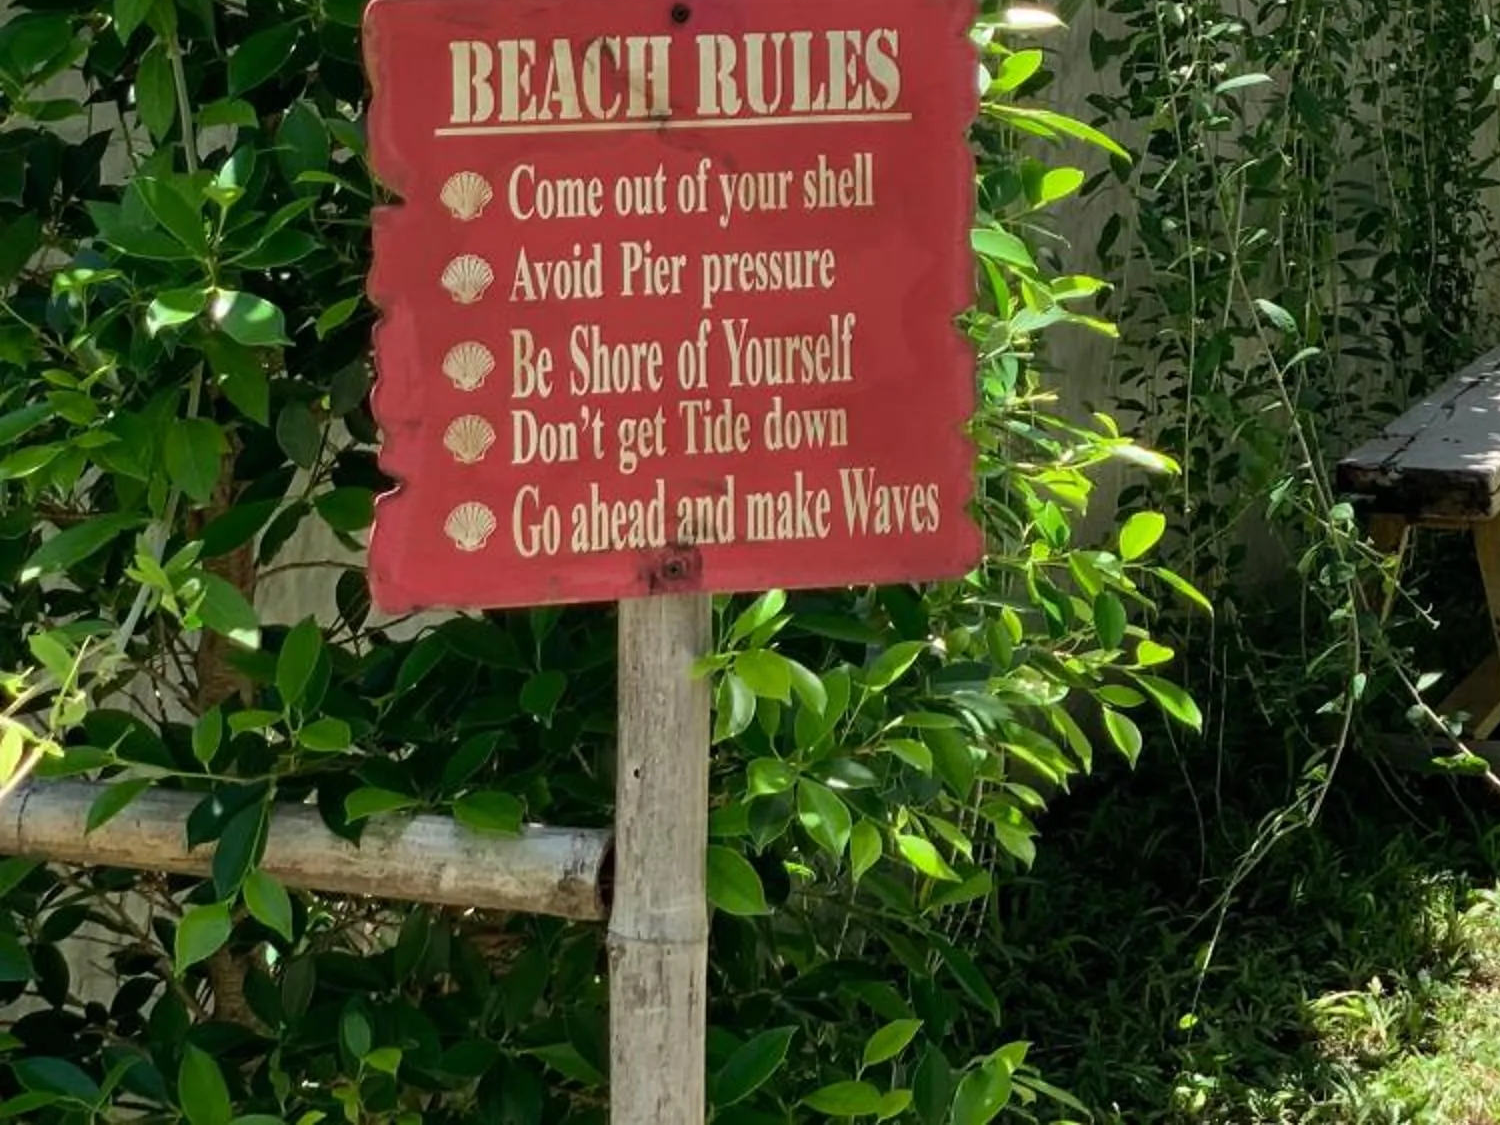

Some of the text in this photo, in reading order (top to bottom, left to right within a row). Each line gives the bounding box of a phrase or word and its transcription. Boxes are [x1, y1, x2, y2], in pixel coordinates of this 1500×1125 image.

[448, 28, 902, 125] BEACH RULES
[508, 153, 874, 228] Come out of your shell
[509, 241, 836, 308] Avoid Pier pressure
[510, 313, 856, 400] Be Shore of Yourself
[511, 397, 849, 474] Don't get Tide down
[512, 467, 940, 558] Go ahead and make Waves
